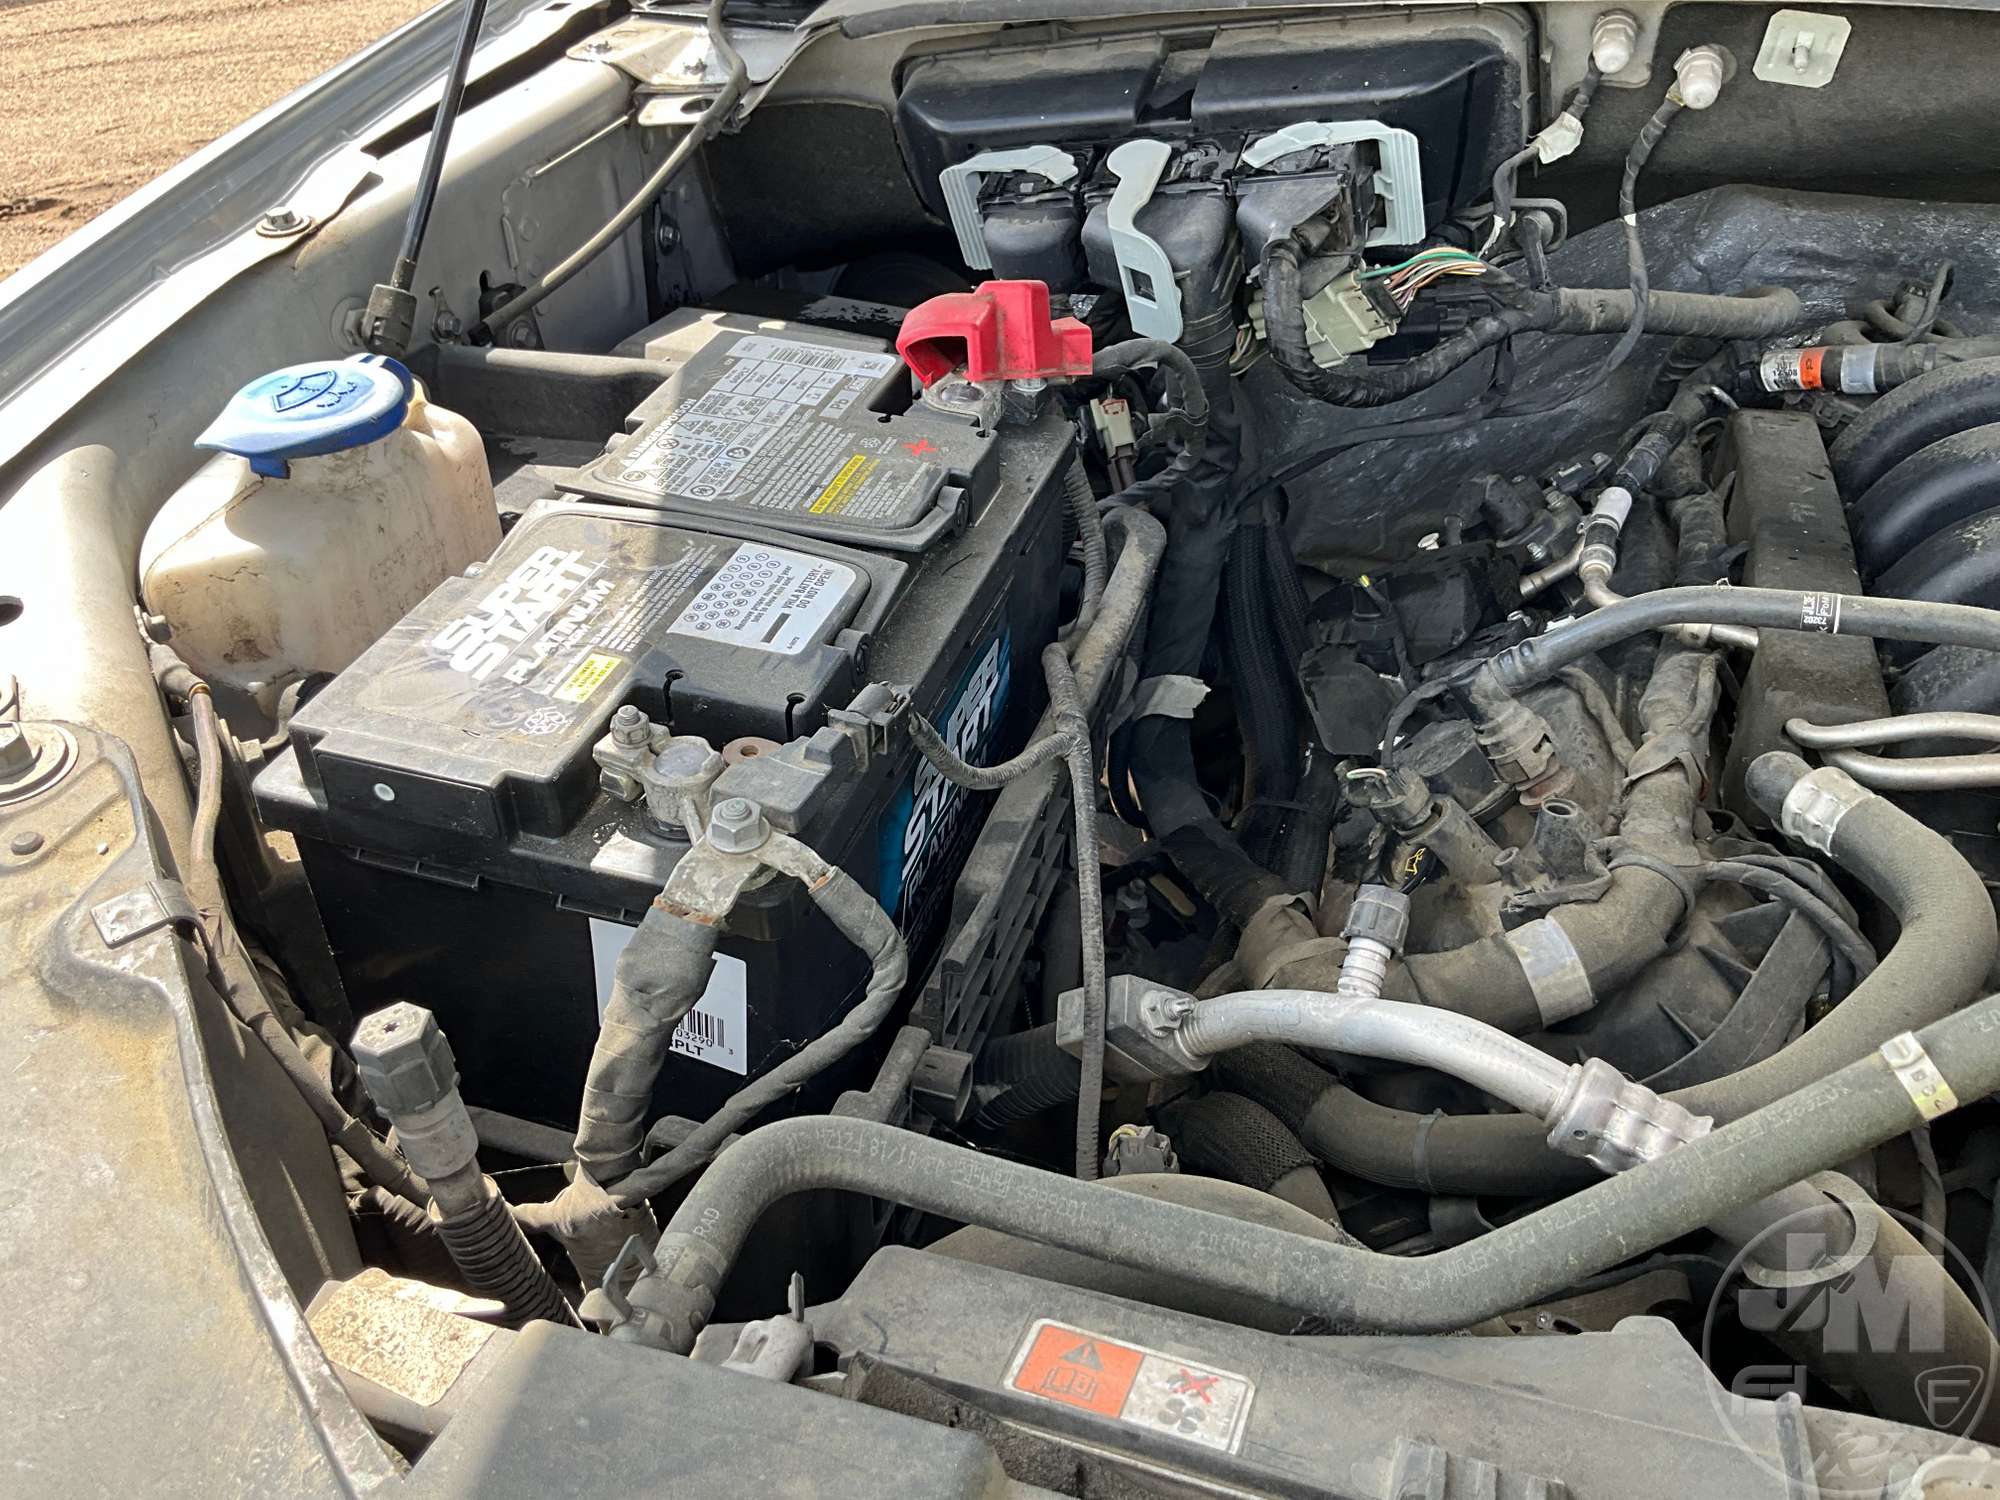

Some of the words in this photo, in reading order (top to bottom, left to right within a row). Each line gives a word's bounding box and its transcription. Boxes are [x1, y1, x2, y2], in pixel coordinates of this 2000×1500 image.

[431, 545, 568, 651] SUPER
[781, 593, 801, 609] VRLA
[794, 568, 821, 593] BATTERY
[796, 599, 810, 608] DO
[803, 586, 820, 599] NOT
[450, 550, 592, 680] START
[502, 578, 617, 684] PLATINUM
[670, 1038, 704, 1056] PLT
[676, 1028, 713, 1048] 03290
[692, 1206, 721, 1236] RAD
